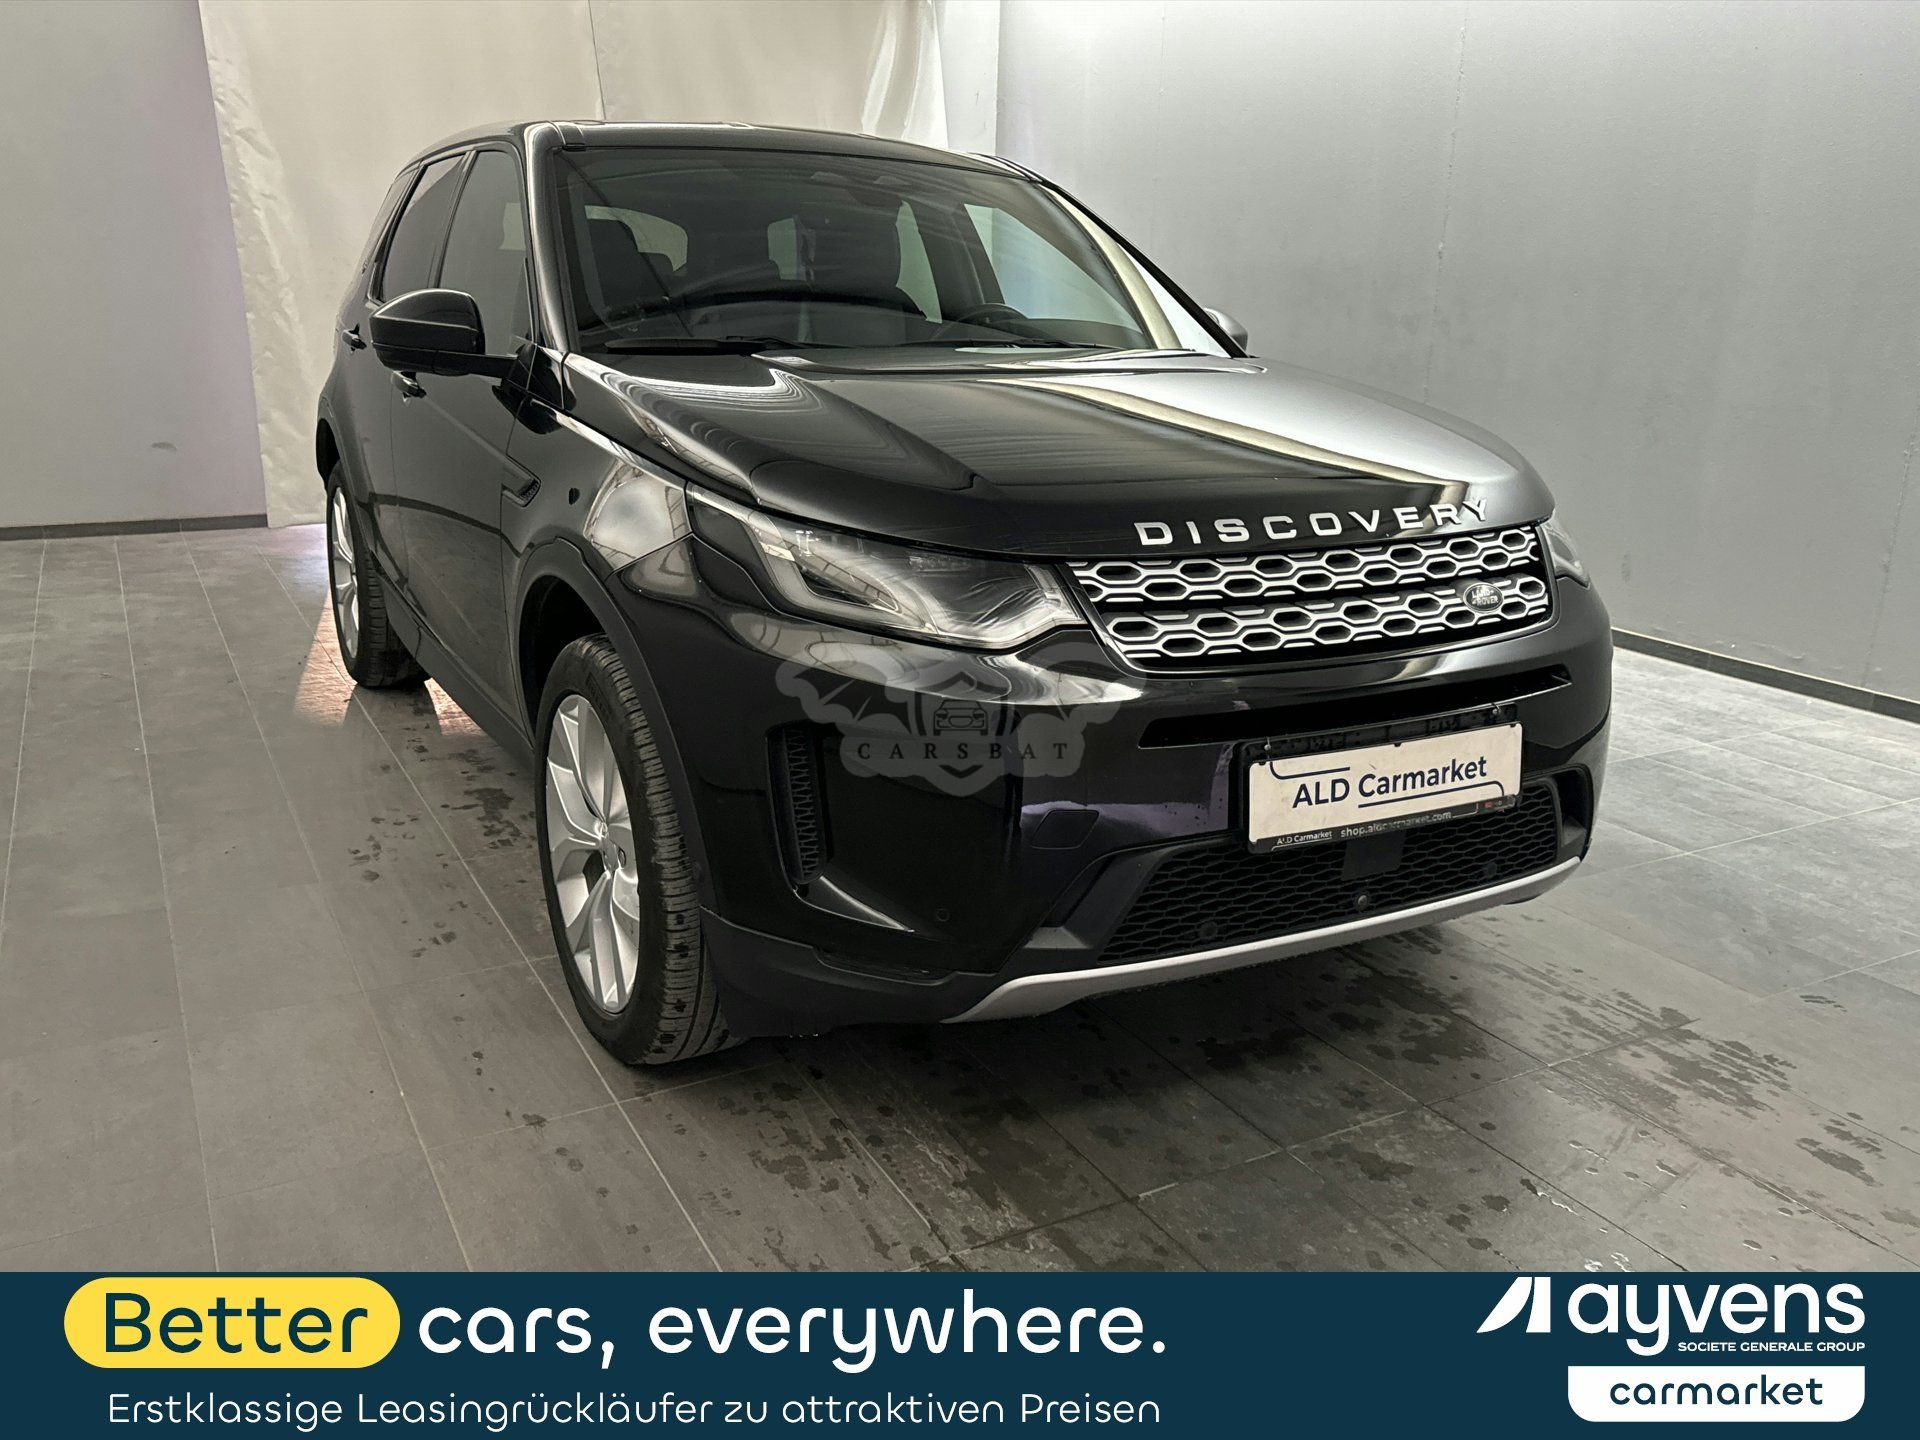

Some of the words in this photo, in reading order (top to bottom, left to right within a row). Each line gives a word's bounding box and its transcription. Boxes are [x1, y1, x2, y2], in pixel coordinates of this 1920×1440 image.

[1133, 499, 1488, 546] DISCOVERY
[1291, 777, 1350, 809] ALD
[1357, 756, 1487, 798] Carmarket
[1276, 836, 1293, 845] ALD
[1293, 830, 1333, 842] Carmarket
